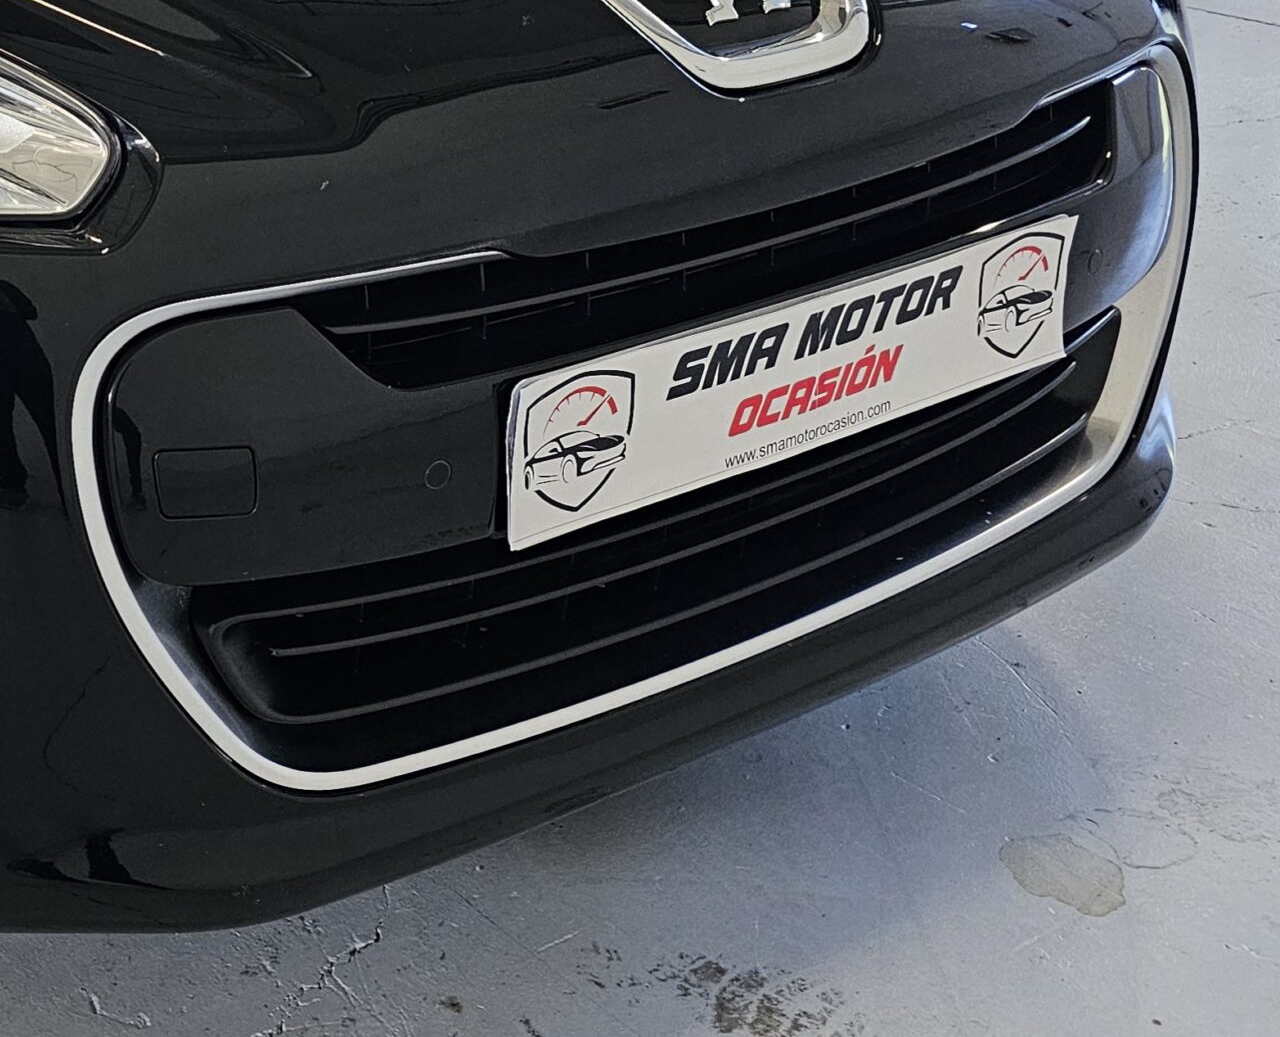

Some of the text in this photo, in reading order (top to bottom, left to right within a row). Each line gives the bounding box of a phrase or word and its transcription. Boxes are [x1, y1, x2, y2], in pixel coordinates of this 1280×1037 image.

[666, 265, 964, 401] SMA MOTOR
[725, 399, 892, 469] www.smamotorocasion.com
[728, 344, 904, 437] OCASIÓN
